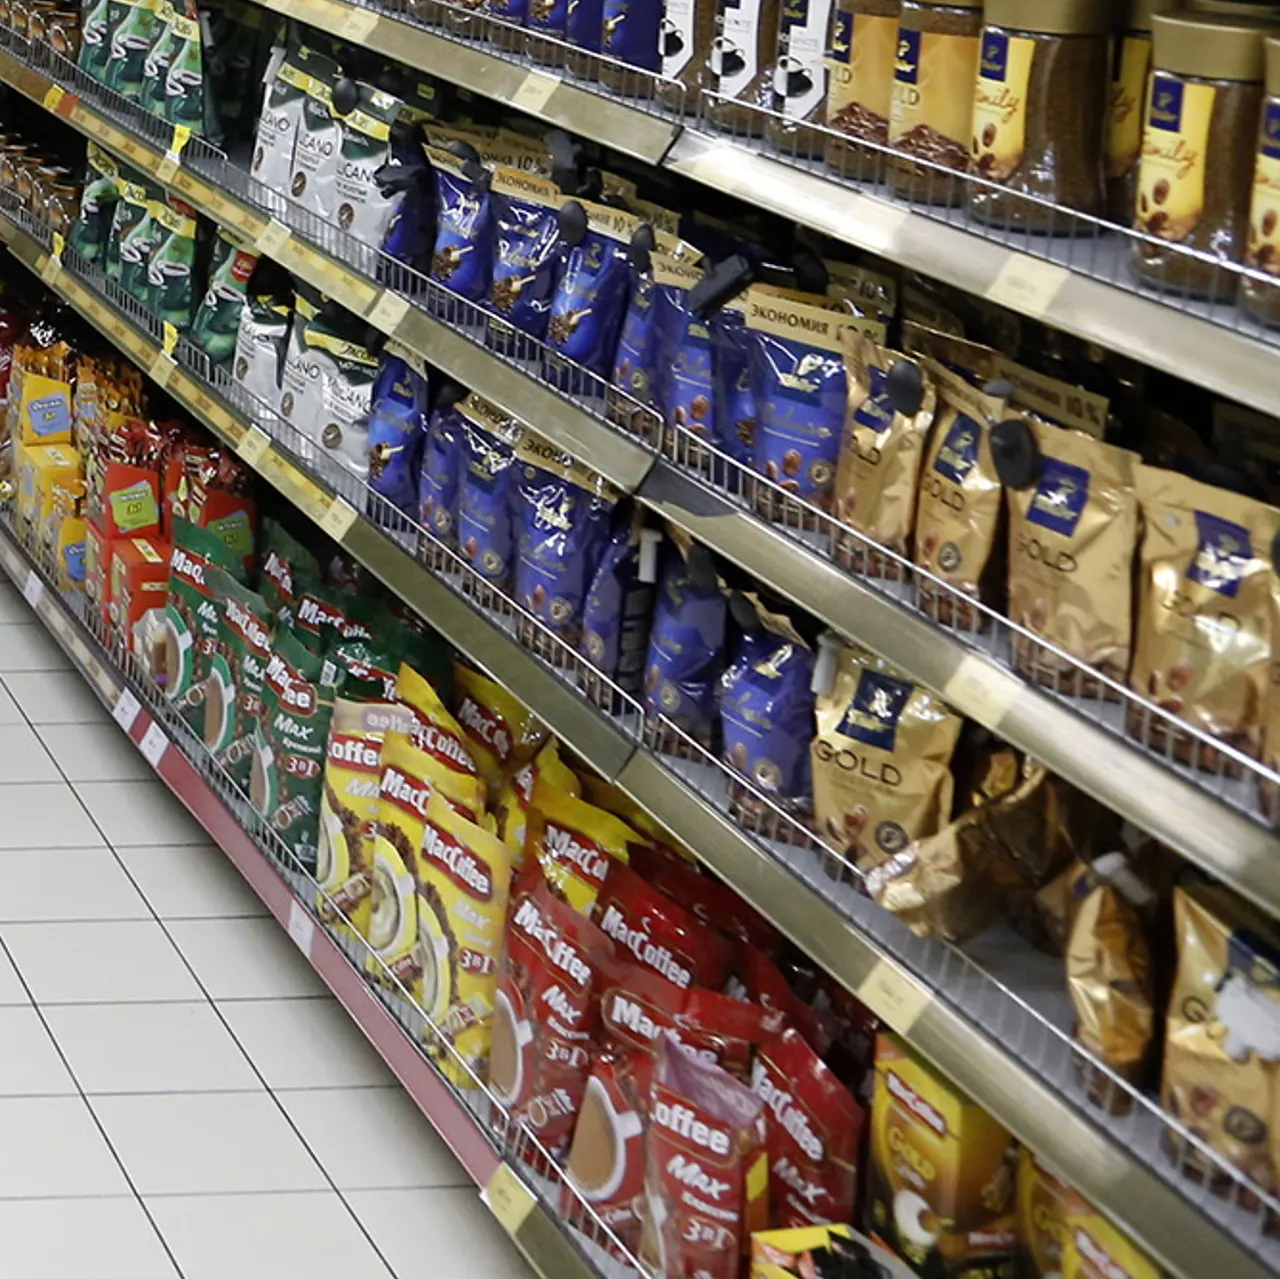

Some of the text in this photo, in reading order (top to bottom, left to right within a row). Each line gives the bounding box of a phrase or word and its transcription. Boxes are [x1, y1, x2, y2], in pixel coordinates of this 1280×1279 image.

[751, 304, 828, 334] ЭКОНОМИЯ
[814, 740, 902, 787] GOLD
[601, 905, 691, 989] MacCoffee
